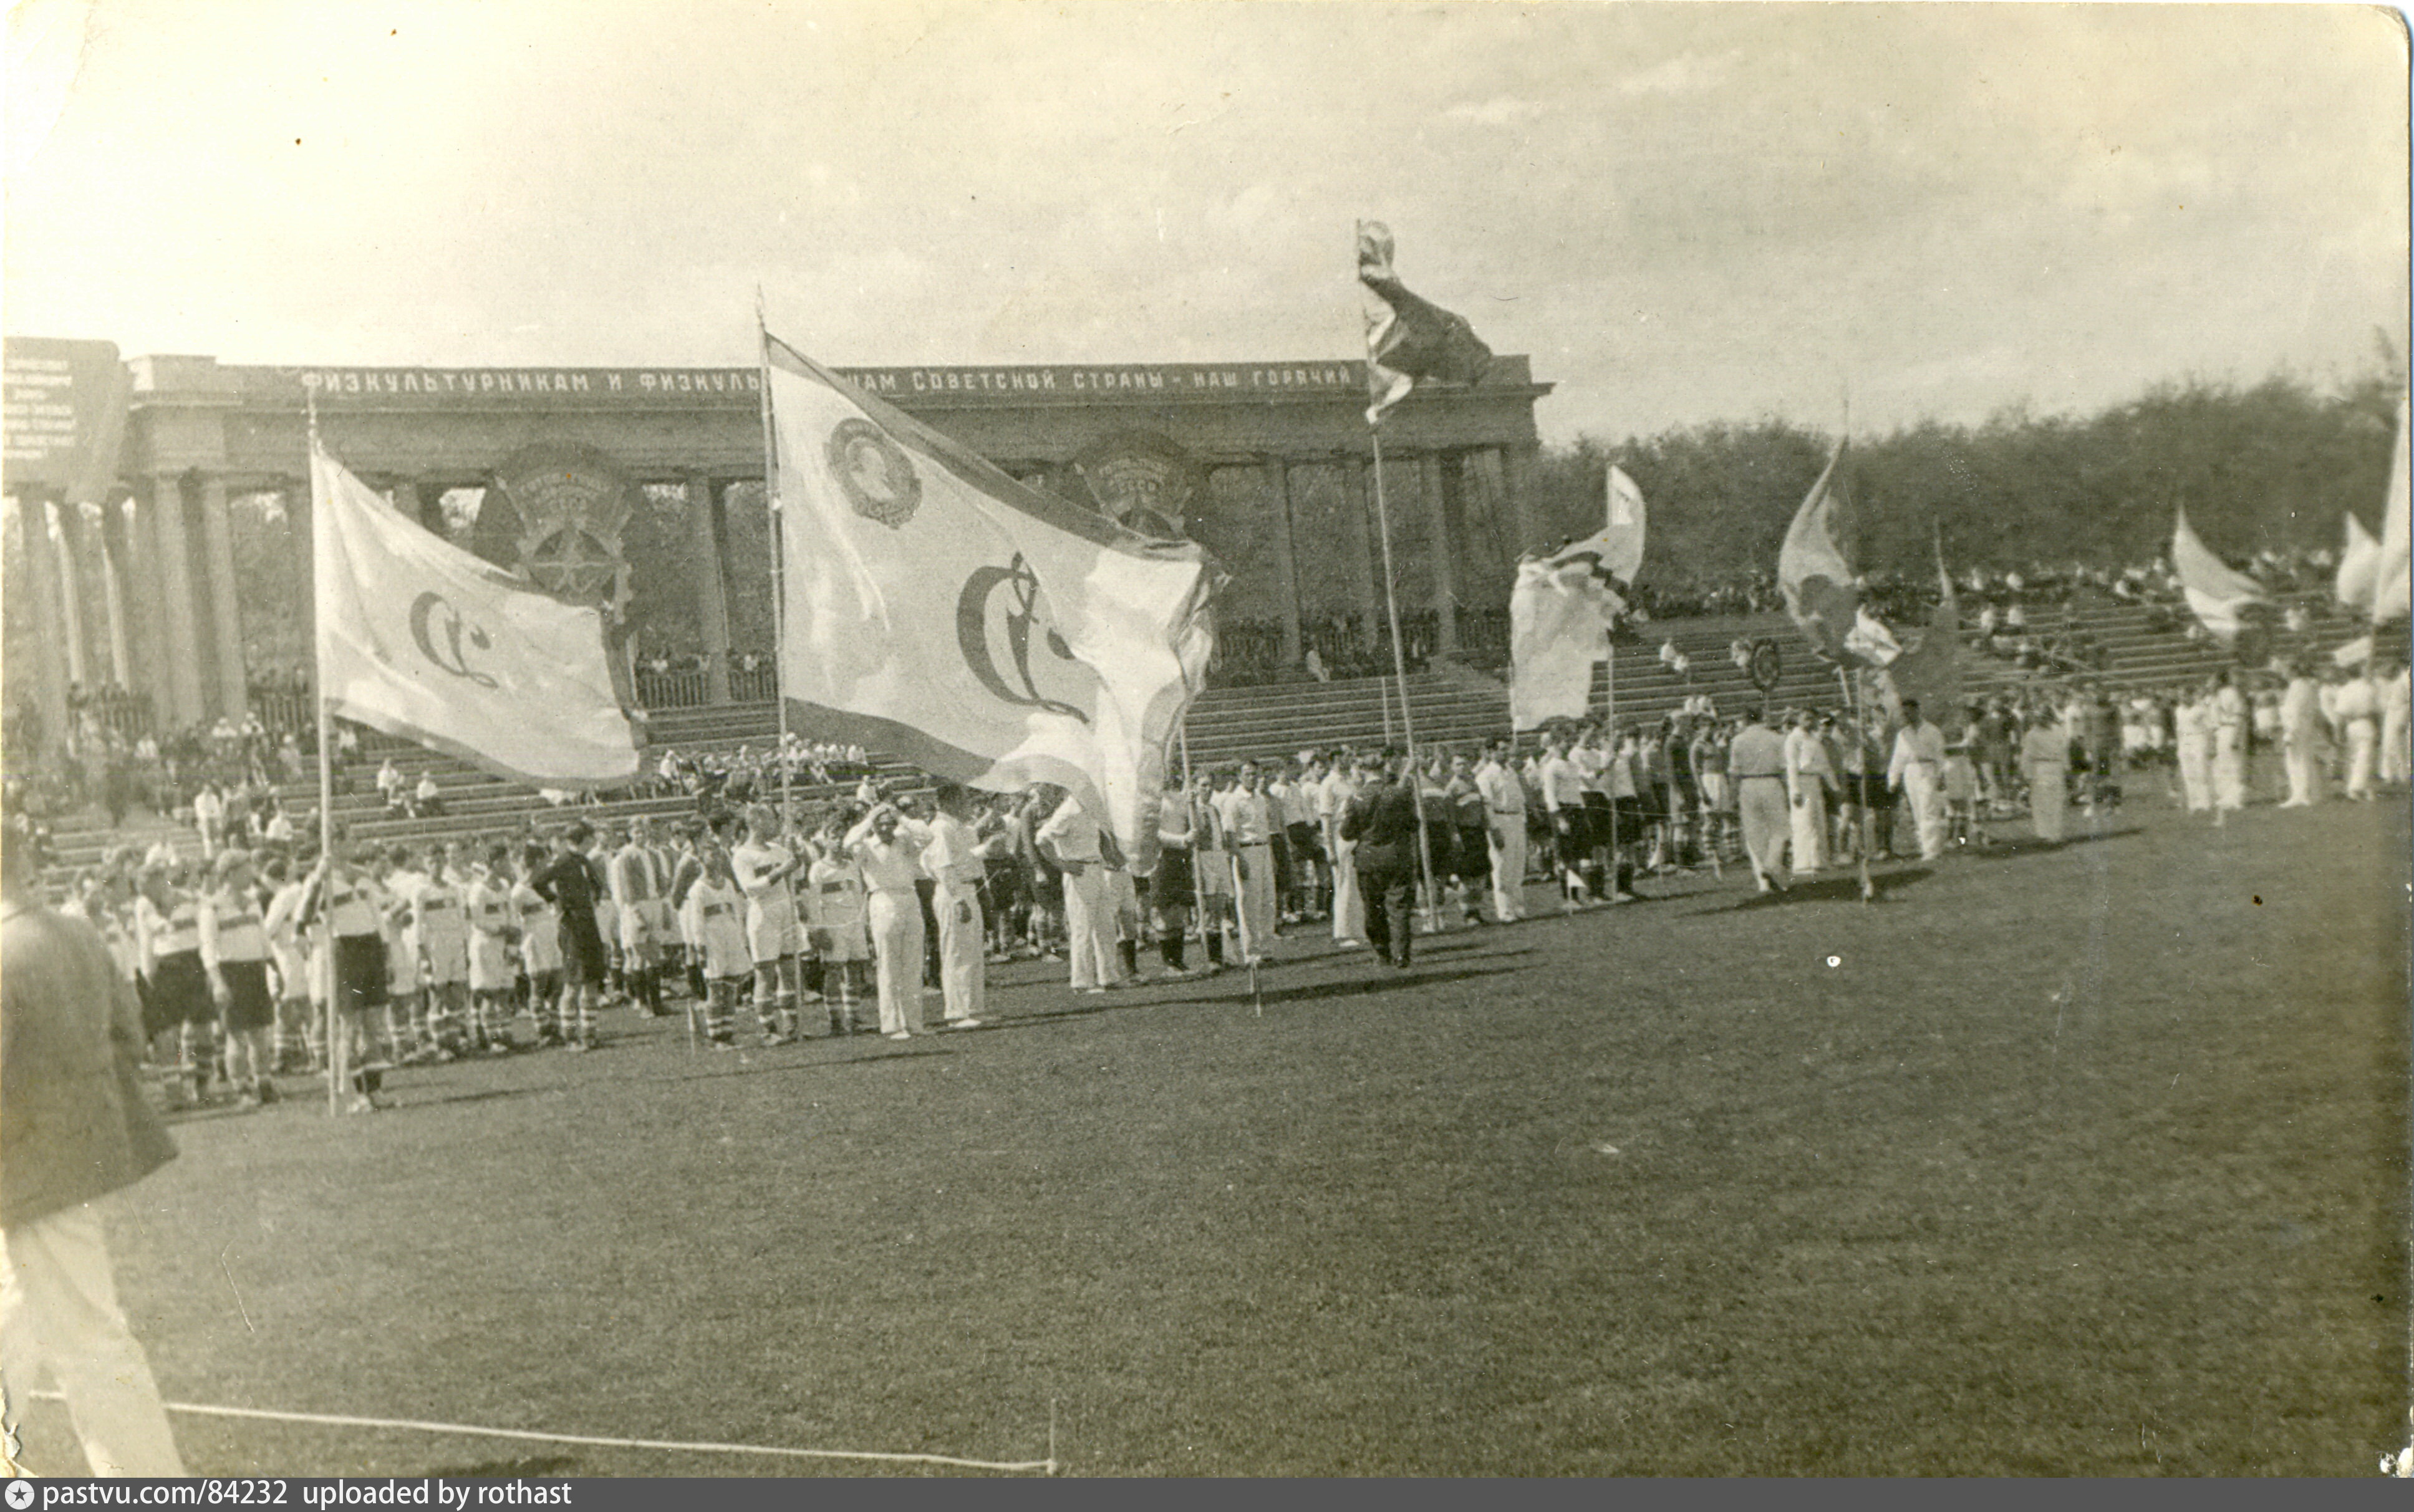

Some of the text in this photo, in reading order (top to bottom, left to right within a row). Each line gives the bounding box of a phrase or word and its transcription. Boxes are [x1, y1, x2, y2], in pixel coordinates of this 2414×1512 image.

[302, 372, 589, 392] ФИЗКУЛЬТУРНИКАМ
[609, 373, 623, 392] И
[912, 369, 1056, 391] СОВЕТСКОЙ
[1073, 372, 1164, 390] СТРАНЫ
[1194, 372, 1237, 387] НАШ
[1252, 365, 1351, 387] ГОРЯЧИЙ
